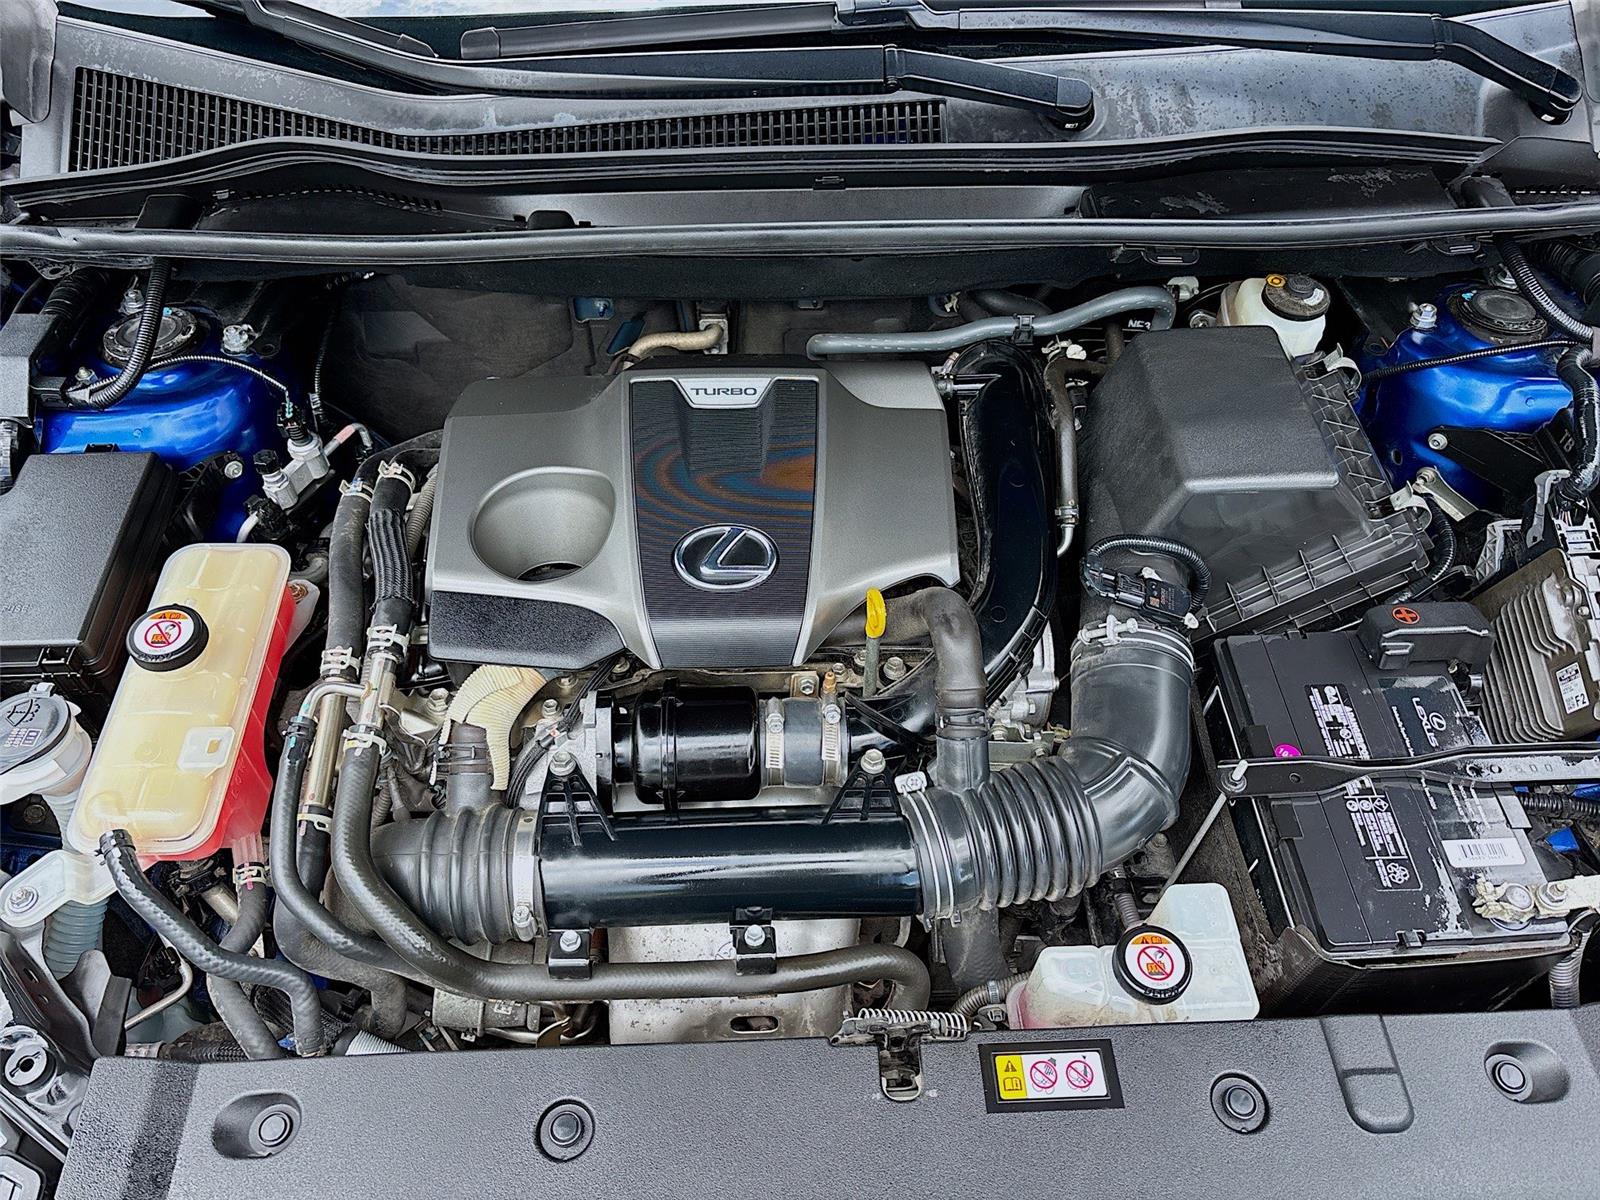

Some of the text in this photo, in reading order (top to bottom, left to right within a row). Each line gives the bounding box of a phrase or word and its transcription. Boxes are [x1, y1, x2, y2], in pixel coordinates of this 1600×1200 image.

[690, 387, 758, 396] TURBO
[1574, 692, 1587, 708] F2
[1412, 697, 1439, 748] LEXUS
